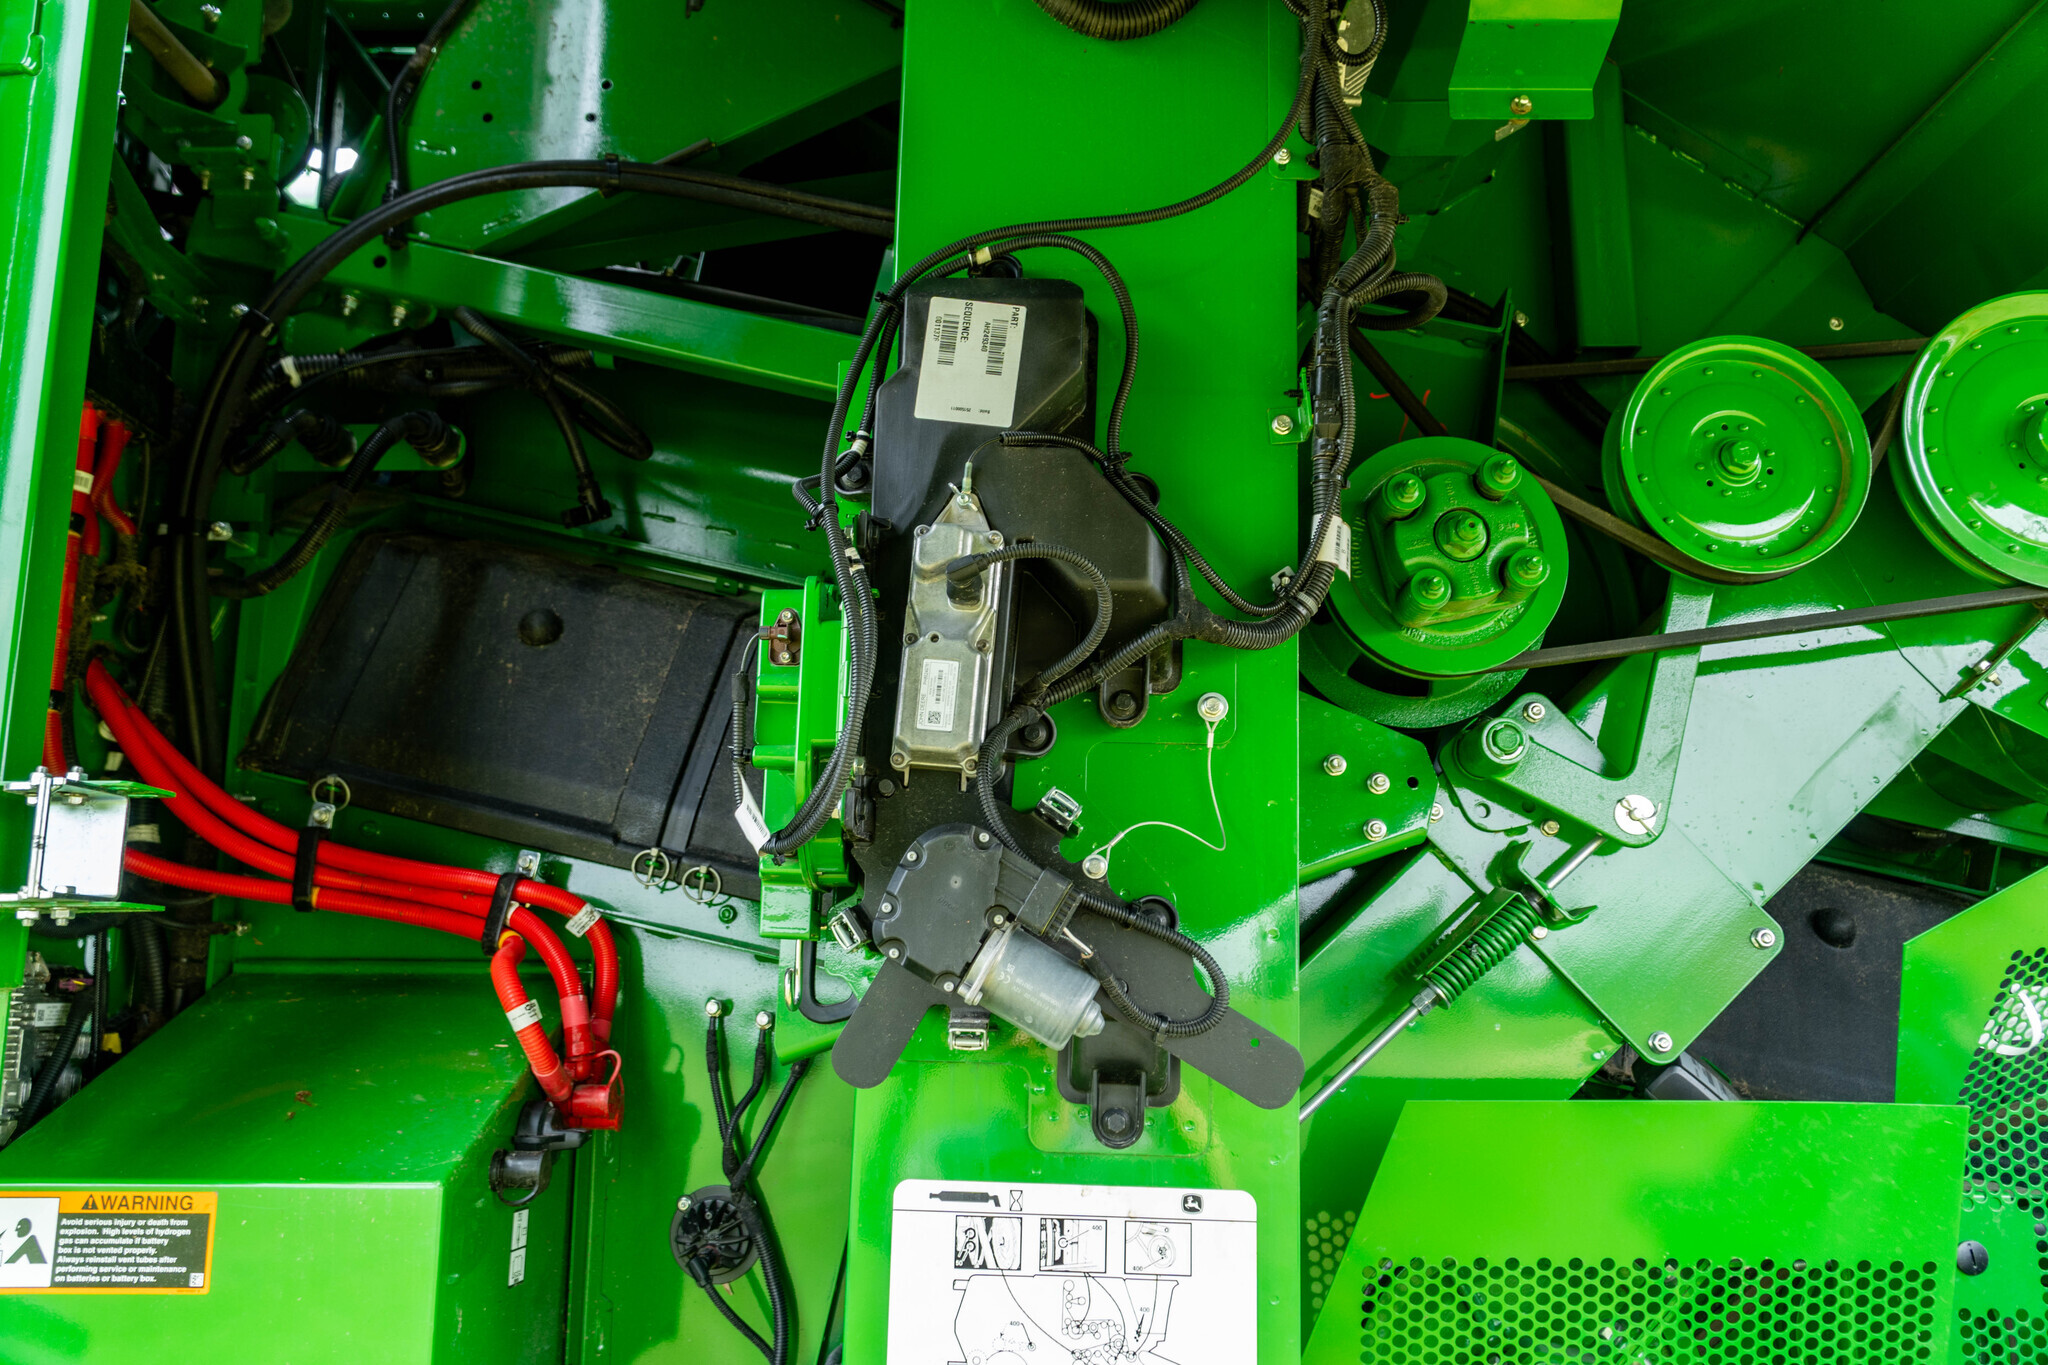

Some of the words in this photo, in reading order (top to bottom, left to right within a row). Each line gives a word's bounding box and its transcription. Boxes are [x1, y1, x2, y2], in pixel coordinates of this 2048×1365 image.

[1010, 306, 1020, 328] PART:
[960, 302, 973, 343] SEQUENCE:
[981, 321, 991, 352] AH249340
[101, 1195, 193, 1210] WARNING
[61, 1218, 83, 1226] Avoid
[114, 1218, 136, 1227] injury
[148, 1218, 169, 1226] death
[170, 1218, 188, 1226] from
[60, 1228, 99, 1236] explosion.
[102, 1228, 120, 1236] High
[155, 1228, 191, 1236] hydrogen
[59, 1238, 73, 1246] gas
[142, 1237, 169, 1246] battery
[97, 1246, 122, 1254] vented
[124, 1247, 157, 1255] properly.
[57, 1256, 84, 1264] Always
[55, 1265, 97, 1274] performing
[112, 1275, 138, 1284] battery
